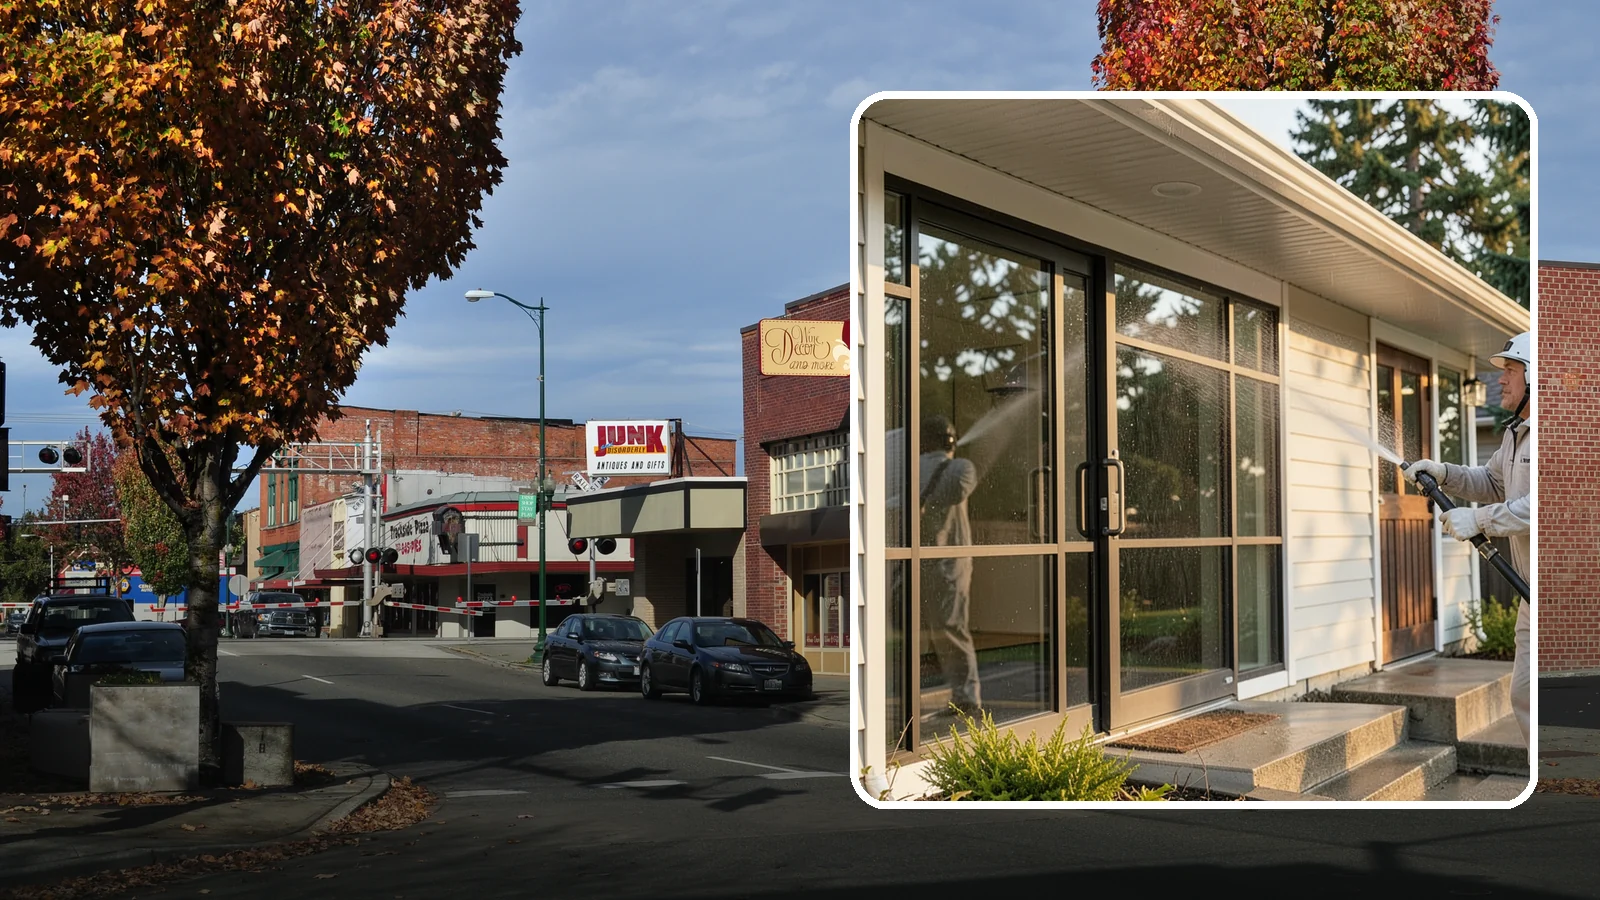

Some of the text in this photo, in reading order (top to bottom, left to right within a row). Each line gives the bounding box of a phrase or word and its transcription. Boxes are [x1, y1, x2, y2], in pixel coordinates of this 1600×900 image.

[765, 327, 830, 365] Decor
[596, 425, 664, 457] JUNK
[607, 446, 645, 454] DISORDERLY
[597, 460, 665, 470] ANTIQUES AND GIFTS
[390, 519, 429, 539] Trackside Pizza
